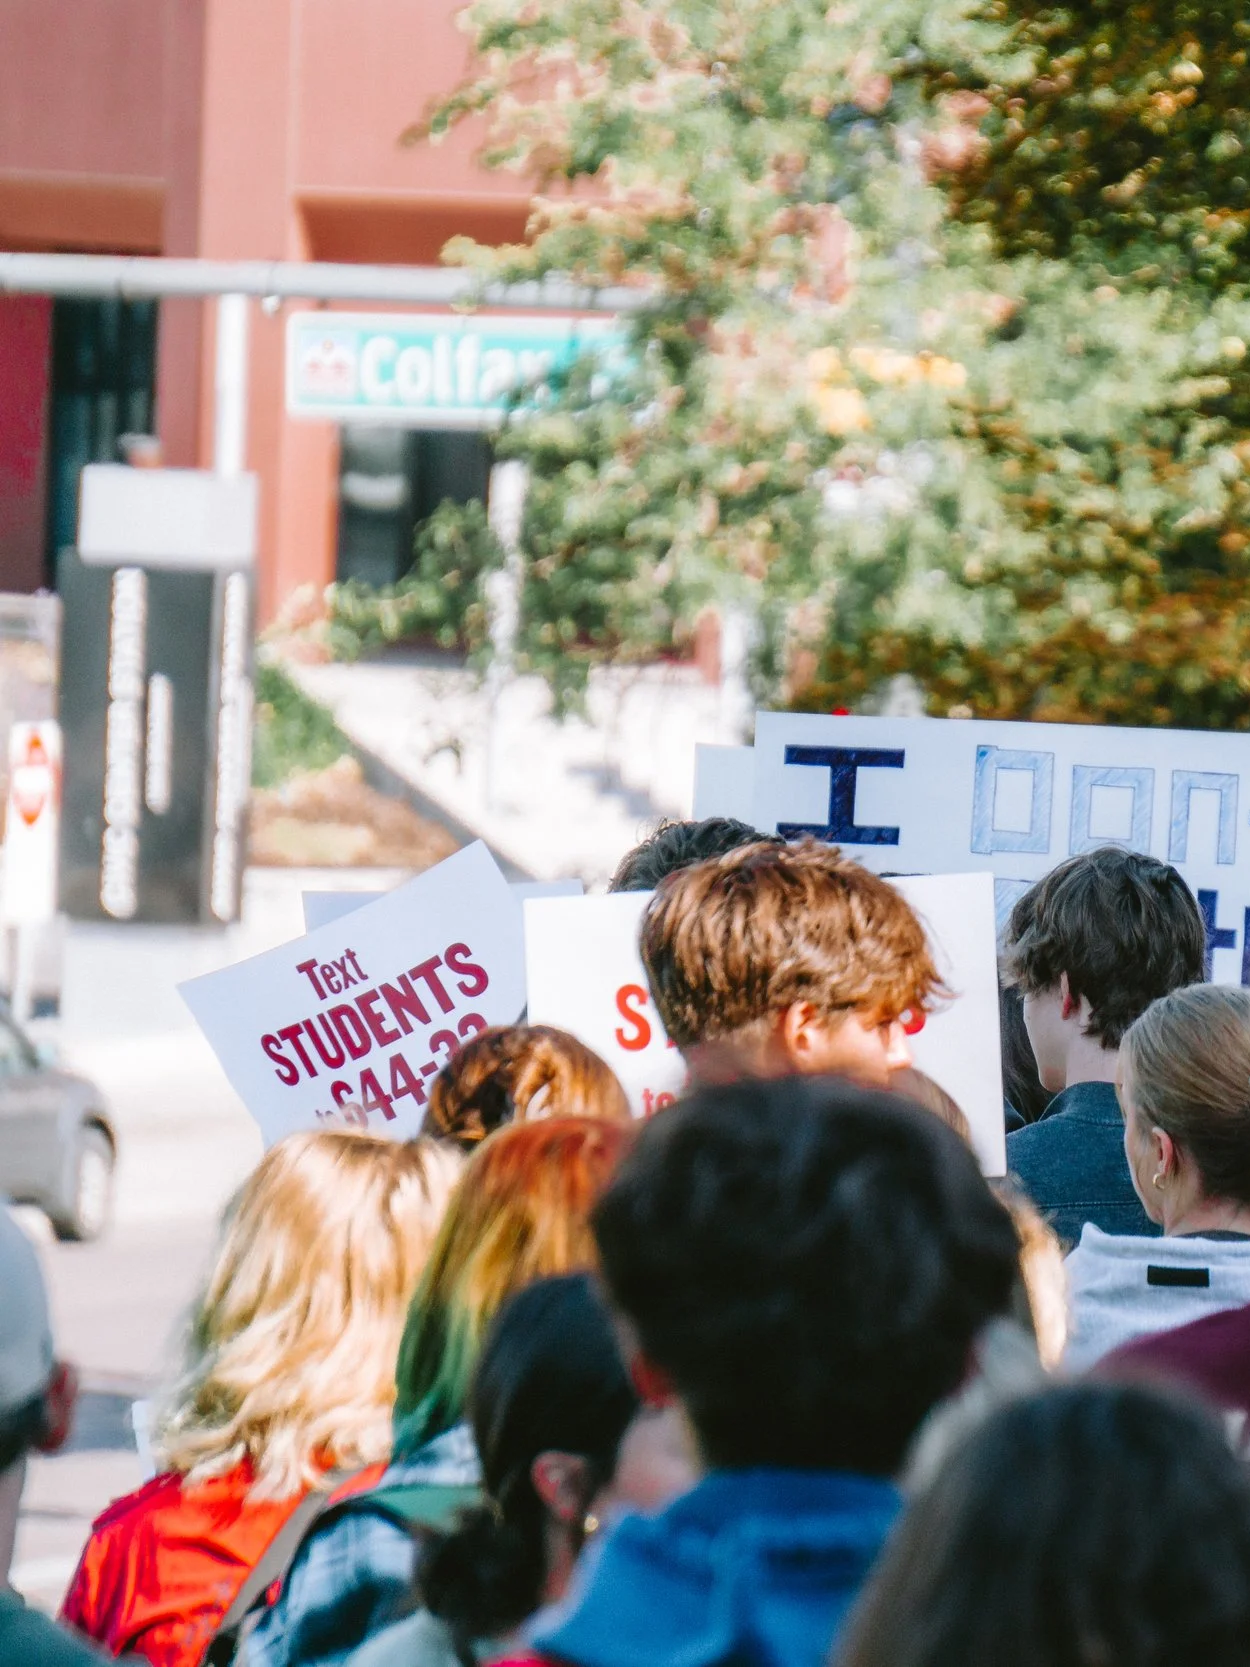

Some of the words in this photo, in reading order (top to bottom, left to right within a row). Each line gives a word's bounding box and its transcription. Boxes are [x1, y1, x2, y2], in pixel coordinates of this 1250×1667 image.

[776, 743, 905, 845] I
[260, 942, 489, 1087] STUDENTS
[296, 948, 368, 1000] Text
